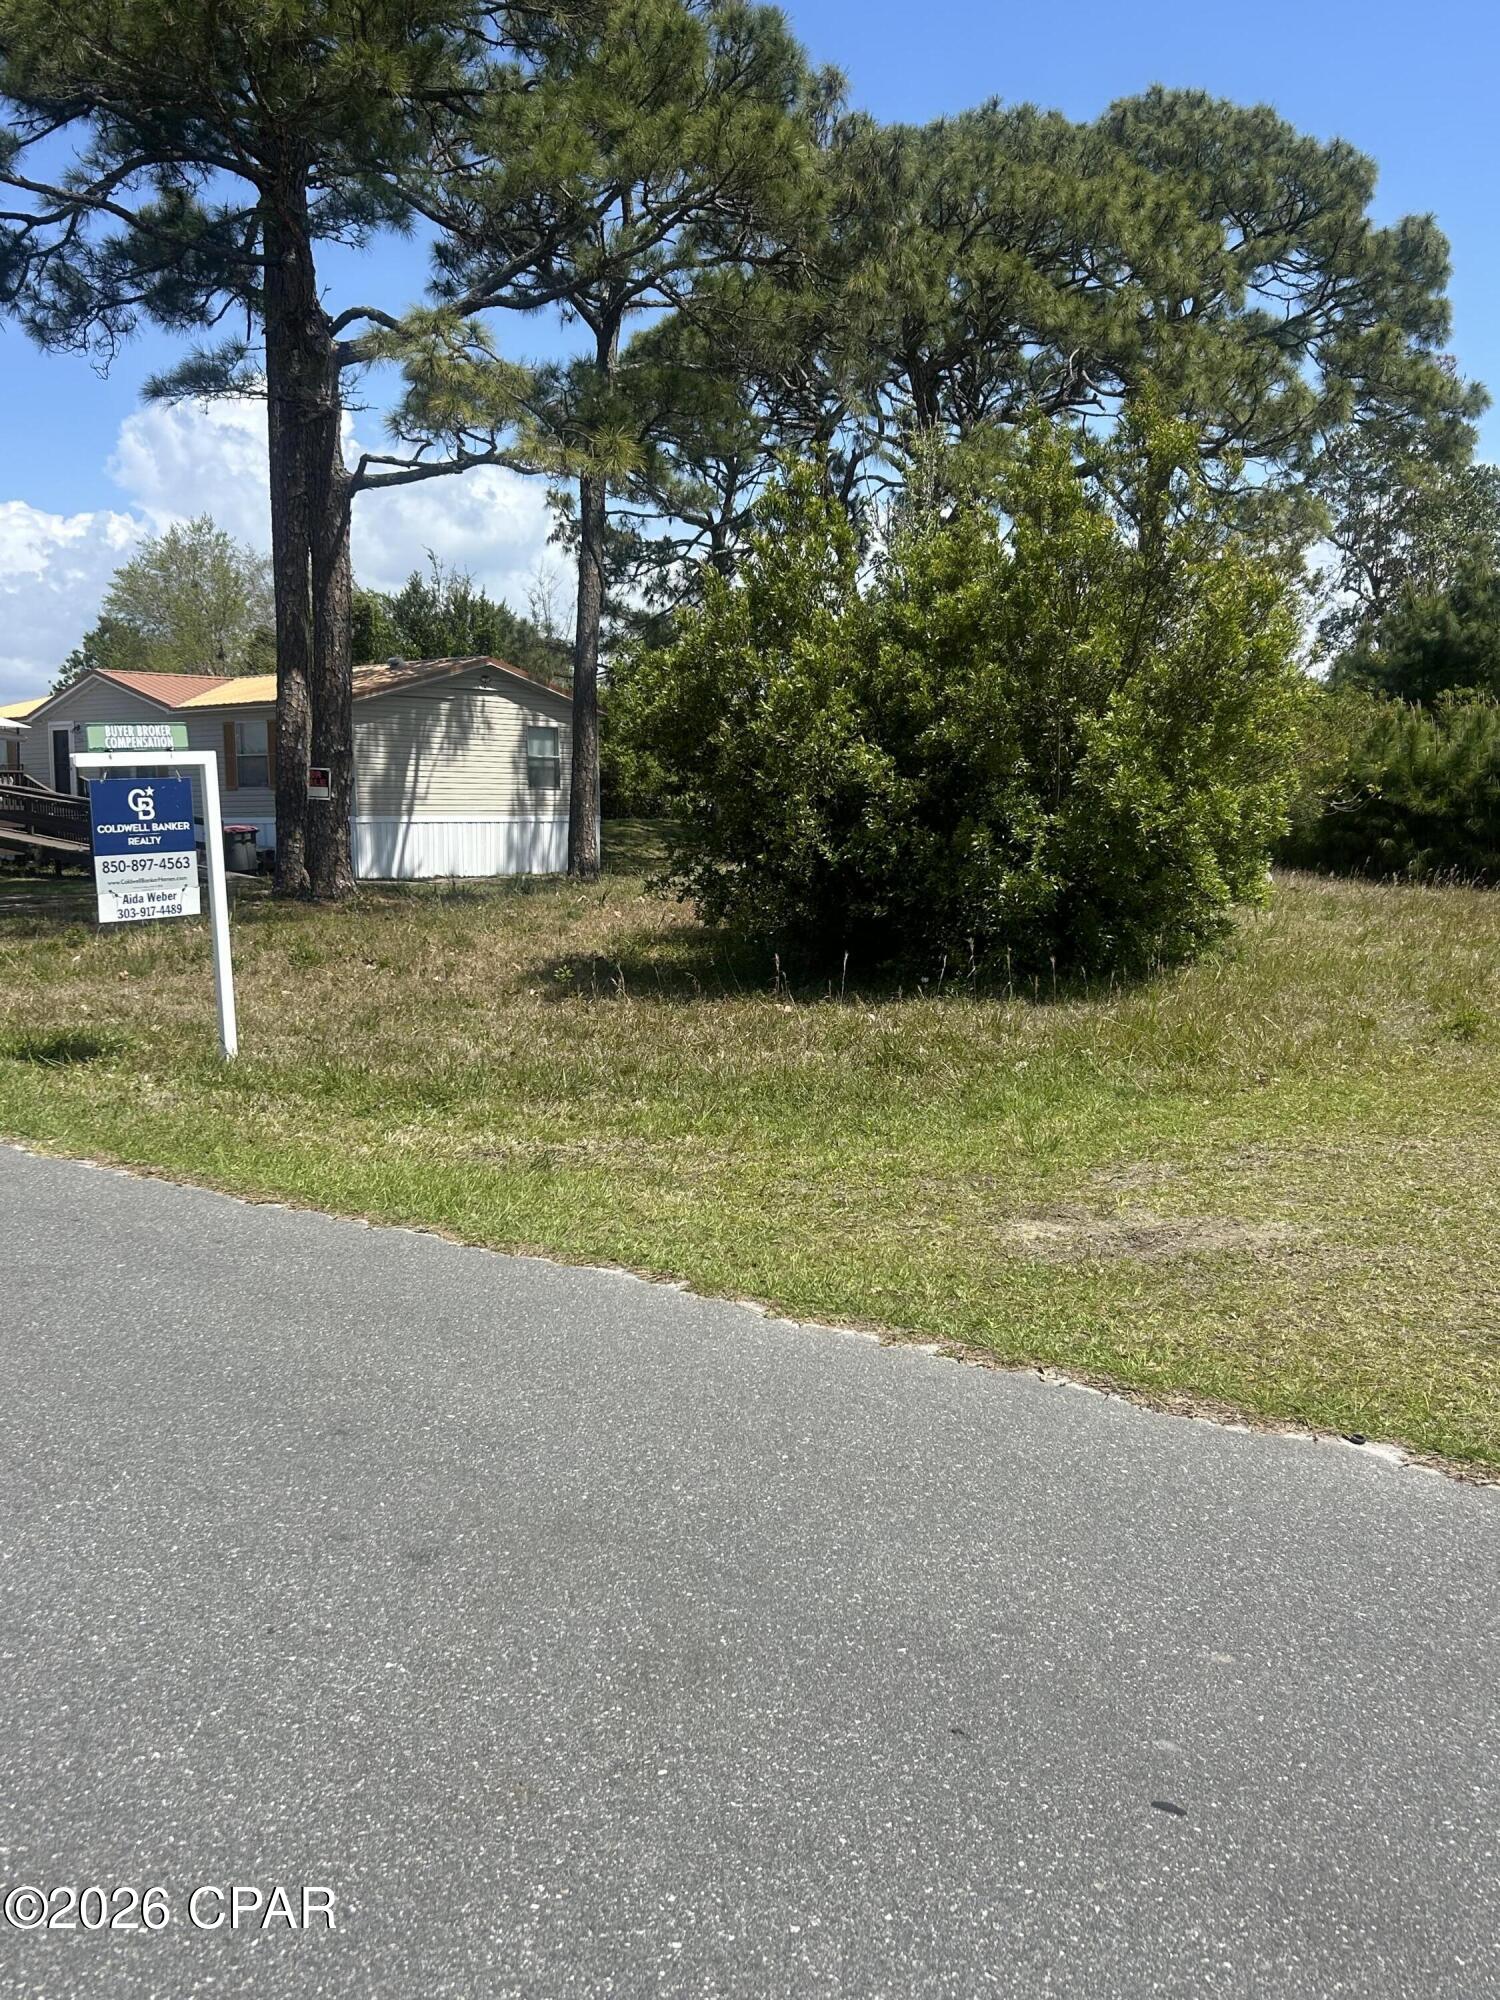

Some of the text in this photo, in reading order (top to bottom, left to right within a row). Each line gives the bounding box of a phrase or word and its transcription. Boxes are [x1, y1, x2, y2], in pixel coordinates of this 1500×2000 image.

[104, 725, 171, 737] BUYER BROKER
[104, 736, 174, 748] COMPENSATION
[97, 821, 190, 834] COLDWELL BANKER
[127, 836, 162, 846] REALTY
[102, 857, 190, 874] 850-897-4563
[122, 892, 177, 905] Aida Weber
[117, 904, 183, 919] 303-917-4489
